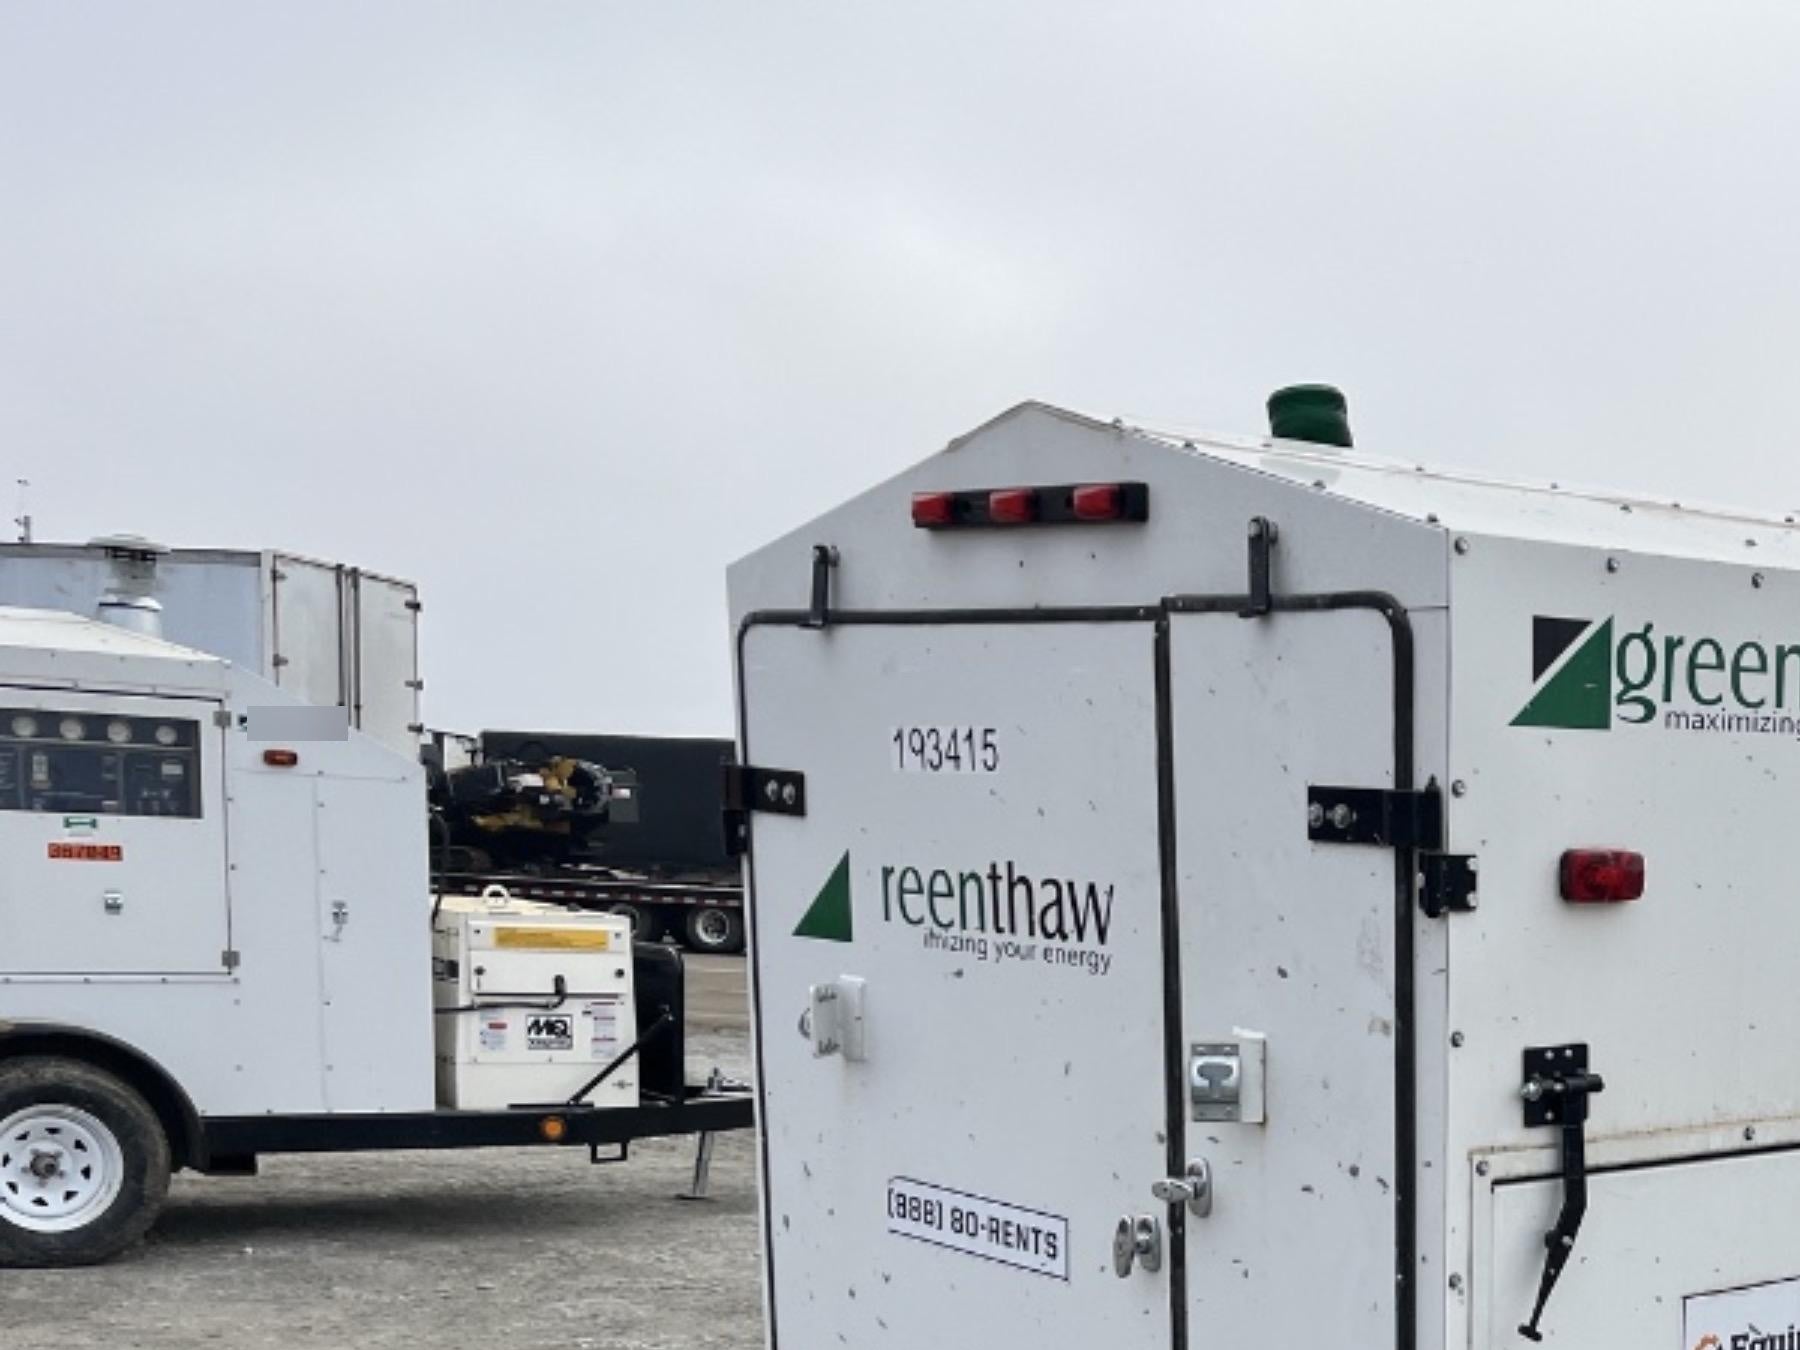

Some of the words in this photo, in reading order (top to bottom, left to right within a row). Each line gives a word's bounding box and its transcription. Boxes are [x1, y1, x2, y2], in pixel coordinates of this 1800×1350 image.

[893, 726, 999, 772] 193415
[881, 860, 1115, 946] reenthaw
[994, 938, 1037, 963] your
[1042, 946, 1112, 976] energy
[887, 1187, 943, 1231] (888)
[950, 1206, 1058, 1261] 80-RENTS
